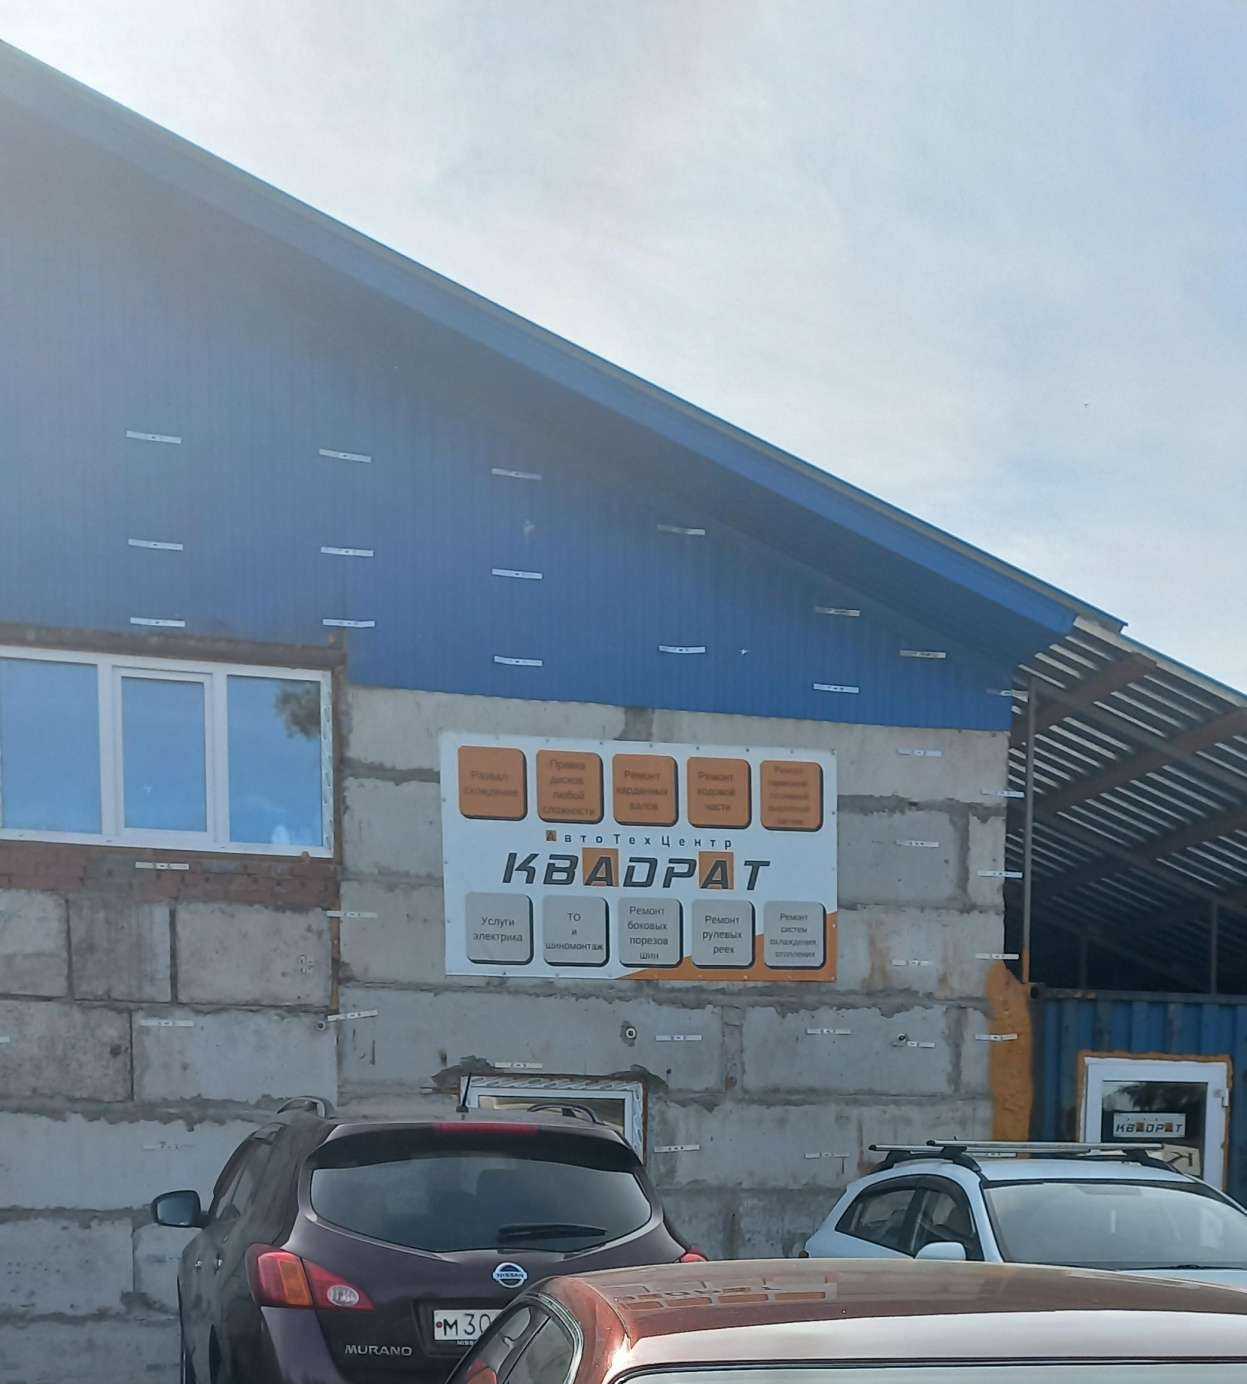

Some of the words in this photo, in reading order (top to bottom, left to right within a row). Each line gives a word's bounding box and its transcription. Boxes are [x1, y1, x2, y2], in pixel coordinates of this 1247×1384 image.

[623, 769, 661, 780] Ремонт
[697, 771, 734, 782] Ремонт
[502, 848, 771, 890] КВАДРАТ
[629, 905, 665, 916] Ремонт
[481, 916, 515, 928] Услуги
[567, 912, 582, 922] ТО
[704, 915, 740, 925] Ремонт
[779, 912, 809, 922] Ремонт
[627, 920, 668, 931] боковых
[473, 932, 523, 943] электрика
[629, 936, 669, 946] порезов
[702, 930, 742, 941] рулевых
[545, 942, 604, 952] шиномонтаж
[712, 945, 735, 956] реек
[639, 952, 660, 961] шин
[344, 1344, 412, 1357] MURANO
